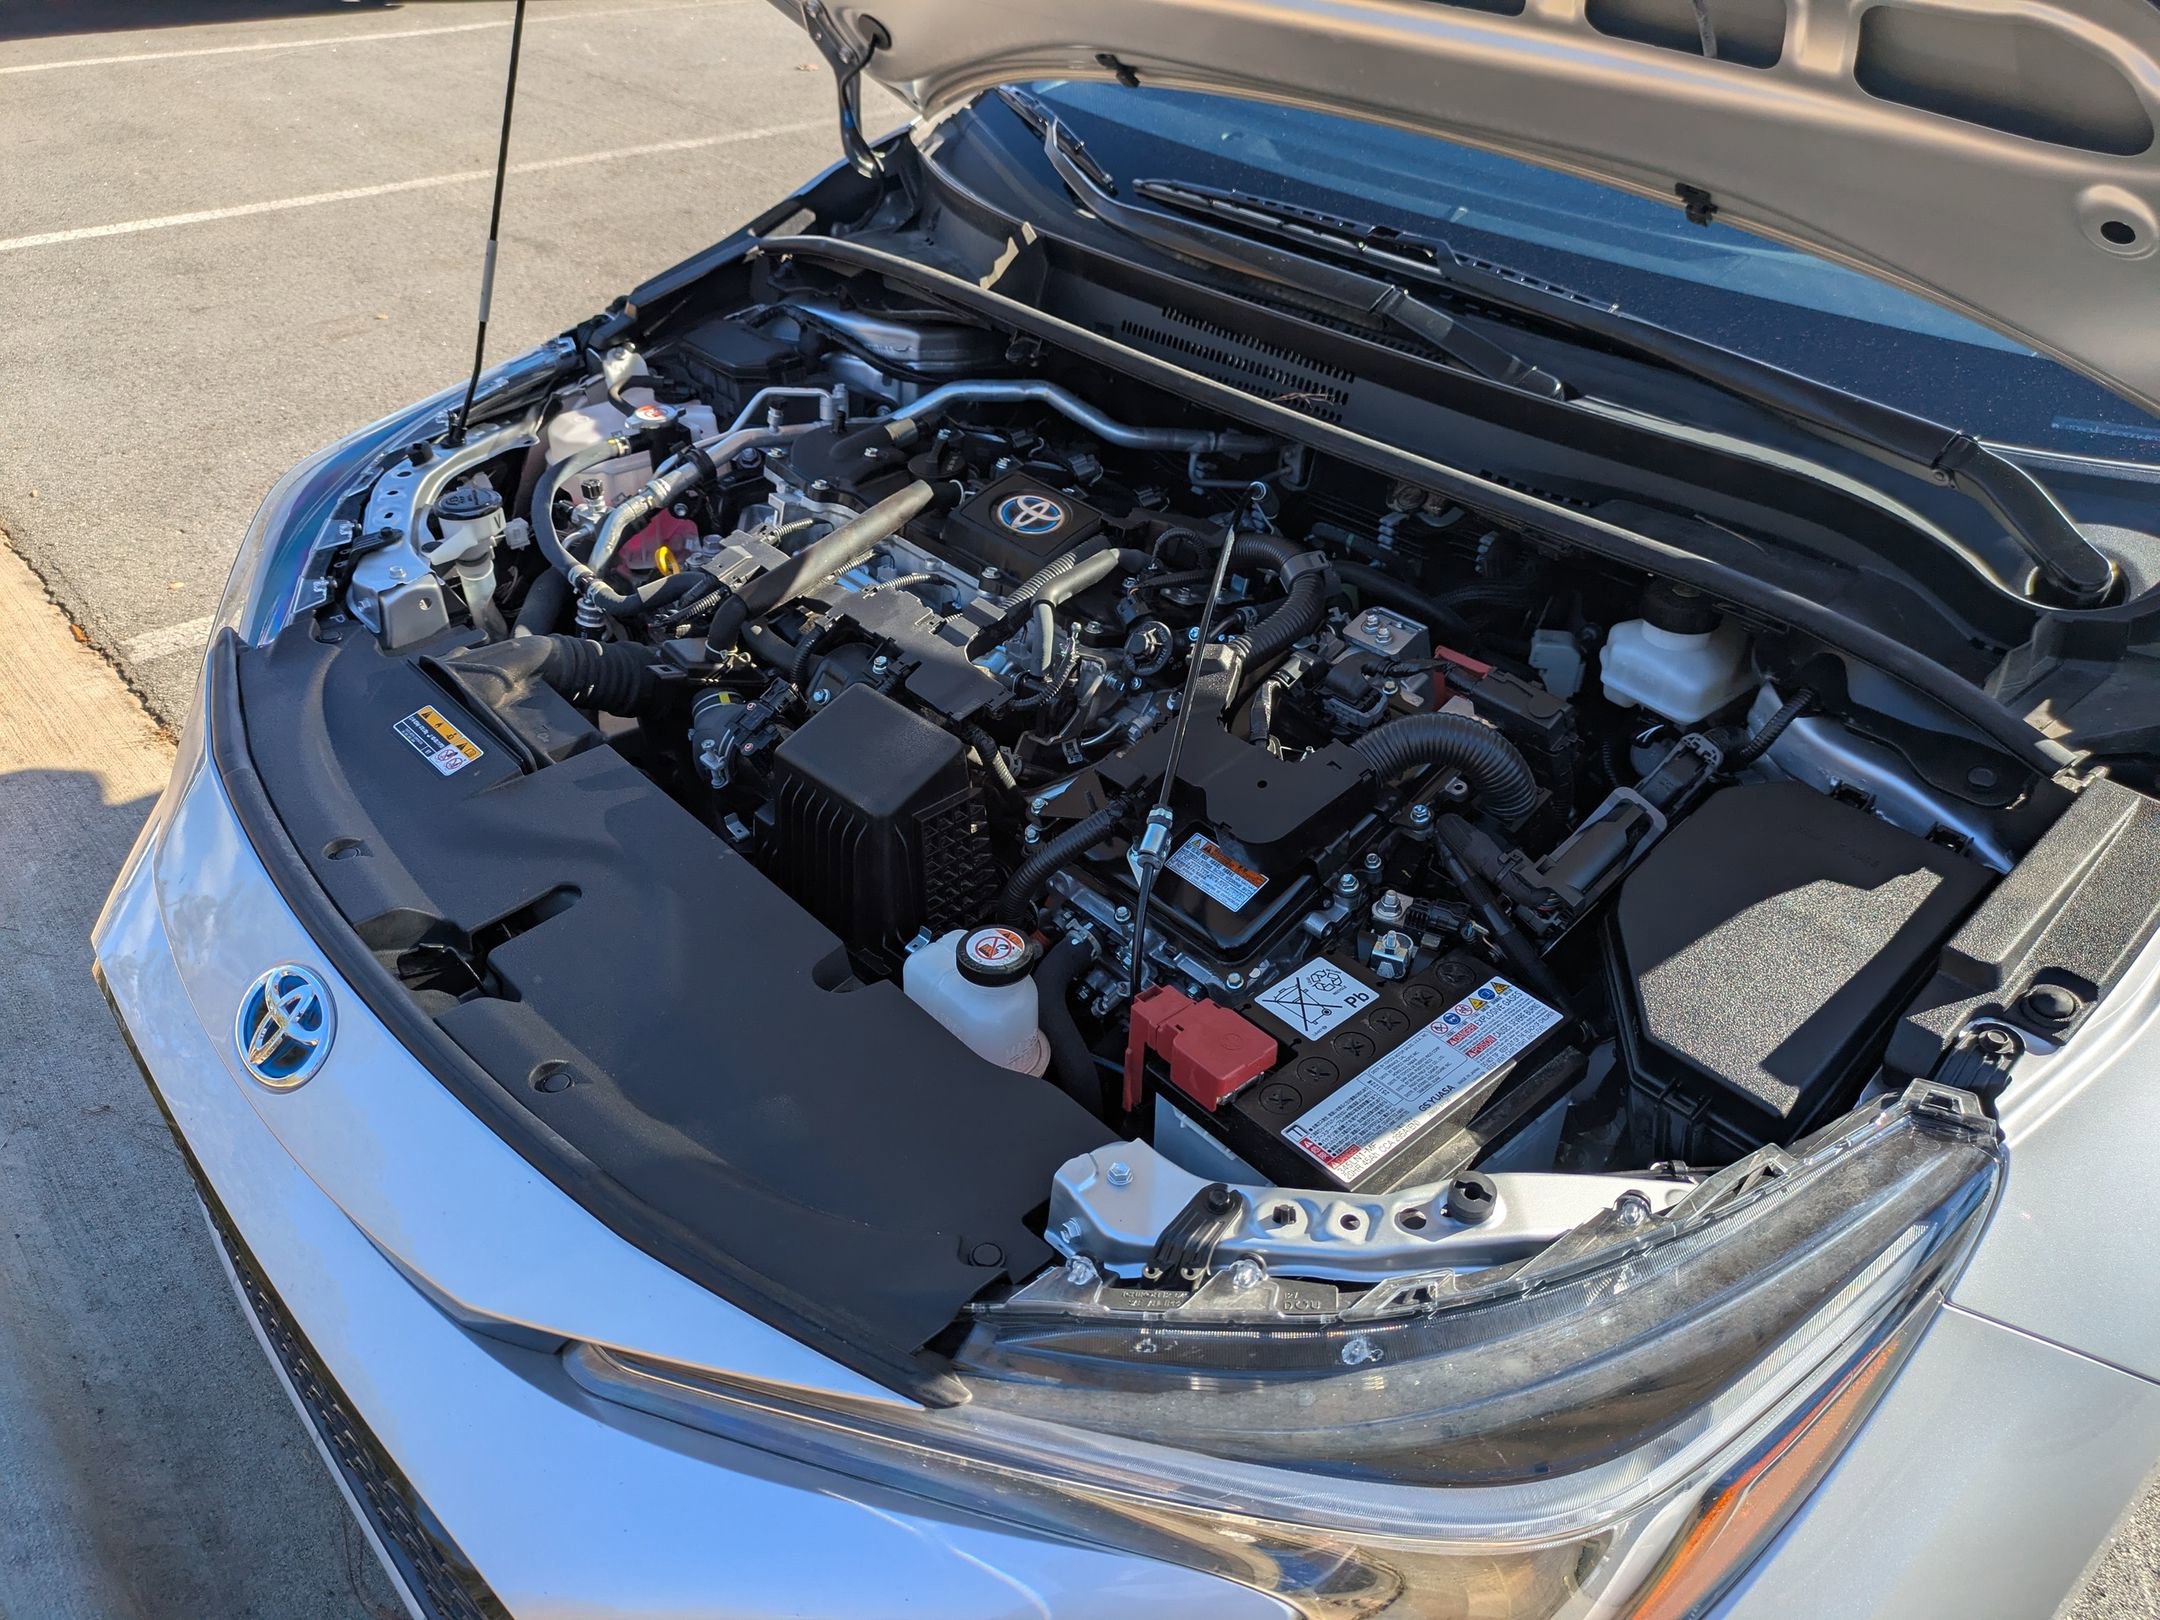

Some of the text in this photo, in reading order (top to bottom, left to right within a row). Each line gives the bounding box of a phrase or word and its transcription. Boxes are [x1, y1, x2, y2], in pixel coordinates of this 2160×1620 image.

[1344, 990, 1371, 1008] Pb
[1453, 991, 1522, 1041] DANGER EXPLOSIVE GASES
[1472, 1037, 1495, 1053] POISON
[1493, 1024, 1512, 1038] CAUSES
[1509, 1013, 1528, 1026] SEVERE
[1428, 1084, 1455, 1105] YUASA
[1337, 1142, 1379, 1174] 345LN1-MF
[1344, 1164, 1364, 1179] 20HR
[1362, 1152, 1380, 1166] 45Ah
[1378, 1140, 1395, 1153] CCA
